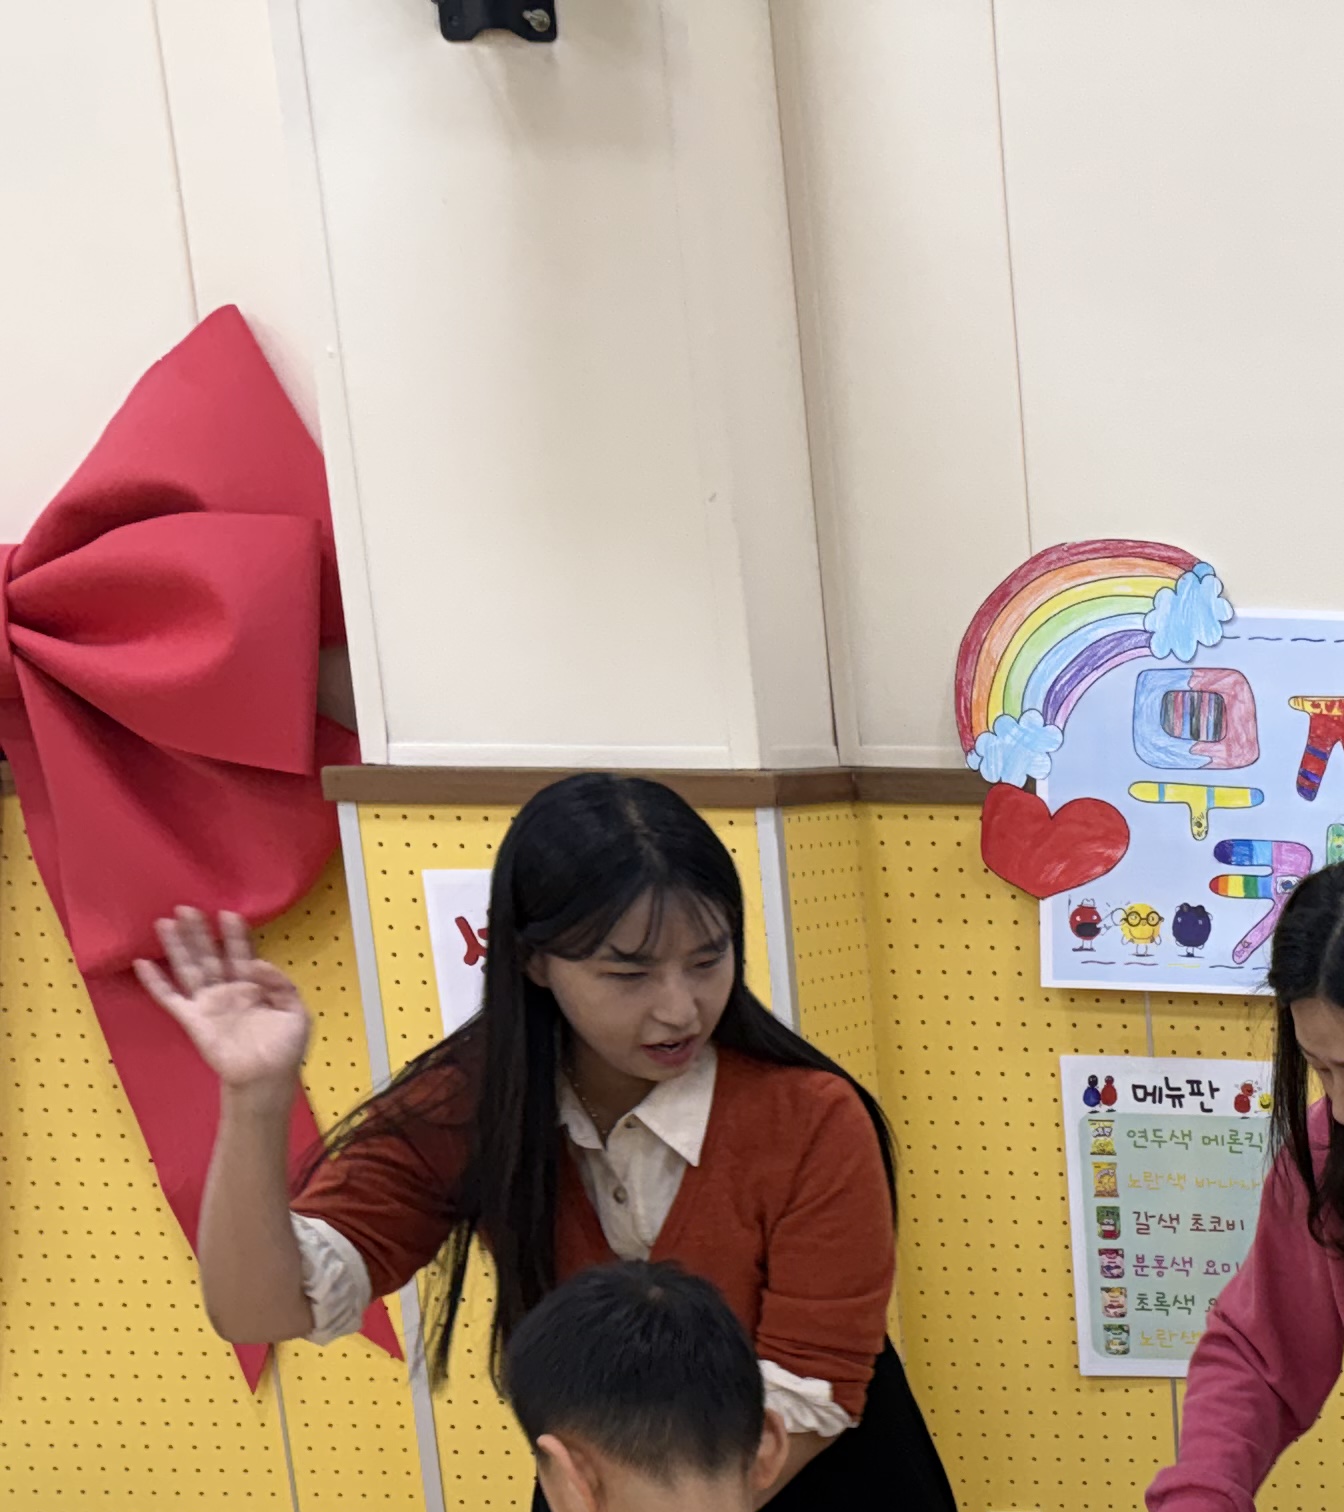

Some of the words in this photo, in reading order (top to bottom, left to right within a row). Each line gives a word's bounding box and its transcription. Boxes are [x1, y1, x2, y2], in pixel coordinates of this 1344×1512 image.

[1131, 1076, 1221, 1113] 메뉴판
[1126, 1128, 1192, 1151] 연두색
[1202, 1129, 1264, 1155] 메론킥
[1127, 1171, 1187, 1191] 노란색
[1132, 1211, 1180, 1235] 갈색
[1190, 1213, 1245, 1234] 초코비
[1132, 1254, 1194, 1278] 분홍색
[1134, 1291, 1196, 1317] 초록색
